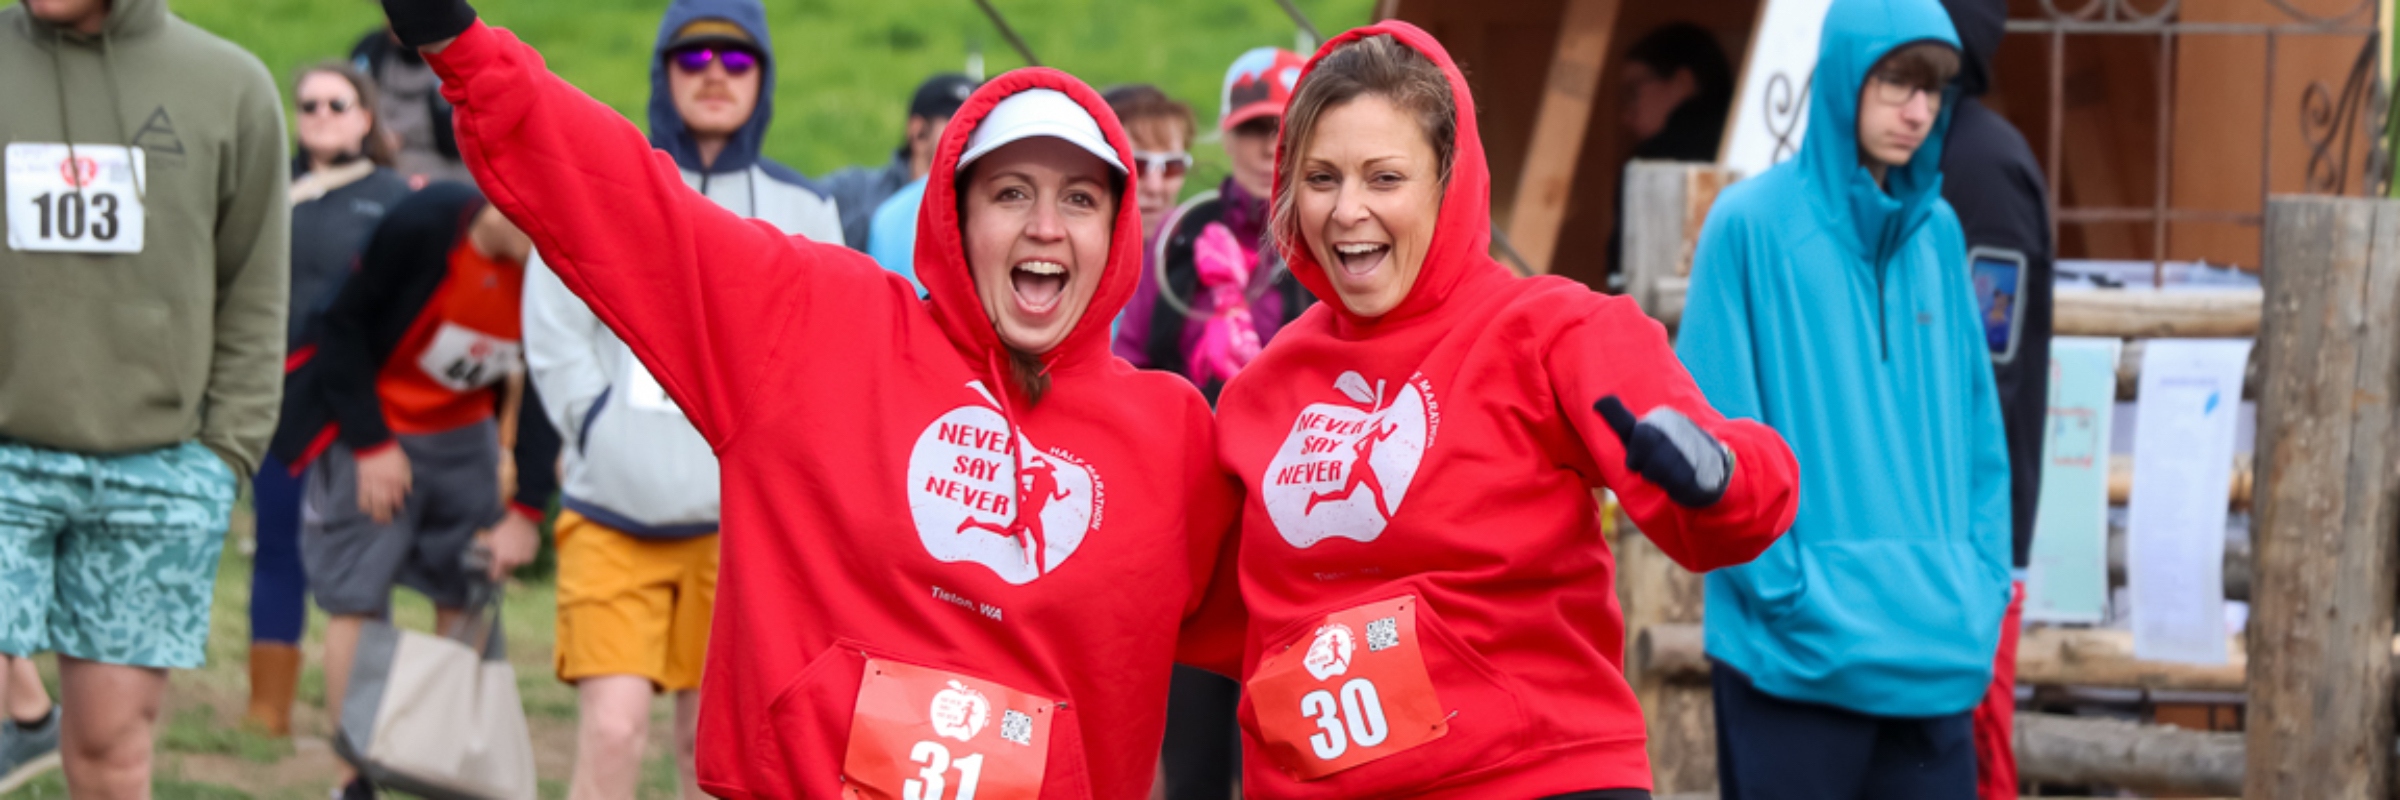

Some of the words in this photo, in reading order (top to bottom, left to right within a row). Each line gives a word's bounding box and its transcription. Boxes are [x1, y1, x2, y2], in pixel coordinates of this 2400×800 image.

[32, 191, 119, 241] 103
[1297, 412, 1367, 434] NEVER
[1301, 435, 1343, 455] SAY
[953, 454, 1000, 482] SAY
[1276, 460, 1343, 486] NEVER
[925, 476, 1010, 516] NEVER
[1085, 464, 1105, 531] MARATHON
[980, 602, 1002, 622] WA
[1300, 677, 1389, 760] 30
[902, 740, 984, 800] 31
